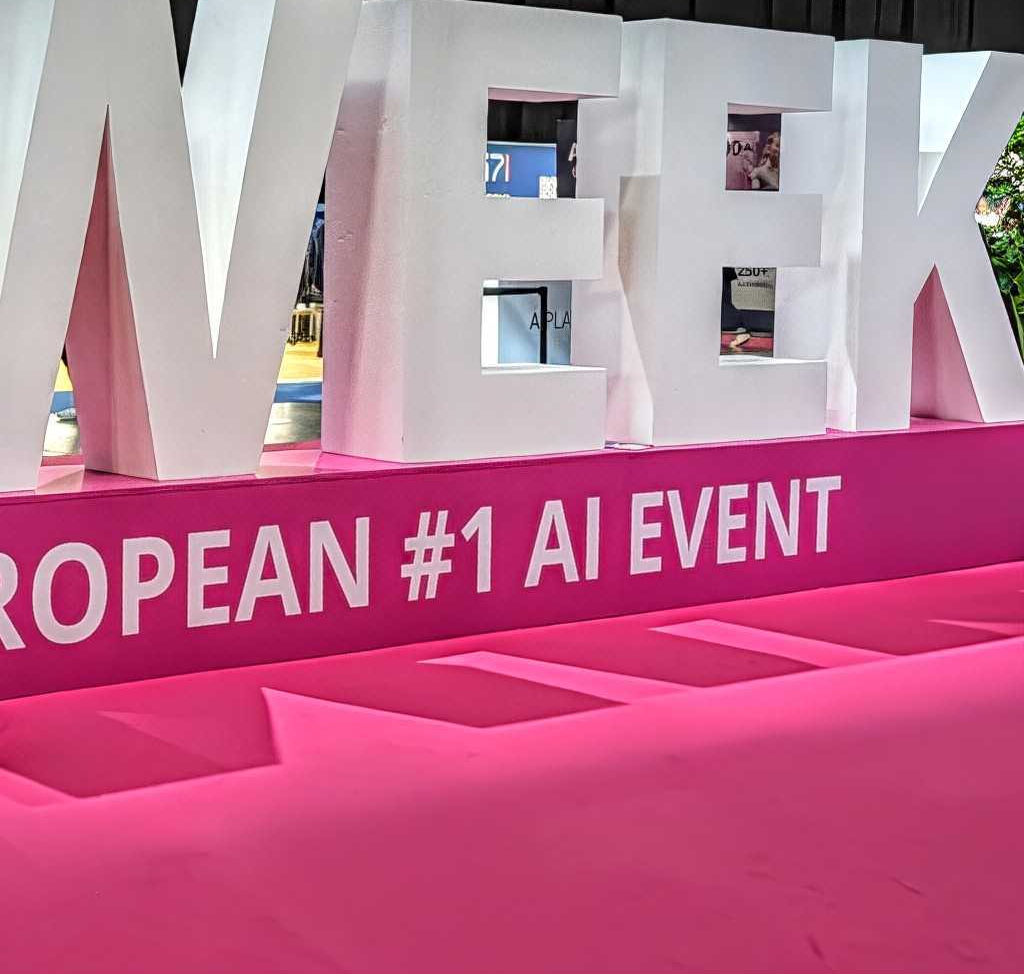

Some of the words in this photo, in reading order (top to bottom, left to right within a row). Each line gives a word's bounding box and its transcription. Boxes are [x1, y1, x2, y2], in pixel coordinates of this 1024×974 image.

[529, 310, 571, 330] APLA
[400, 506, 493, 602] #1
[524, 496, 600, 588] AI
[630, 475, 842, 576] EVENT
